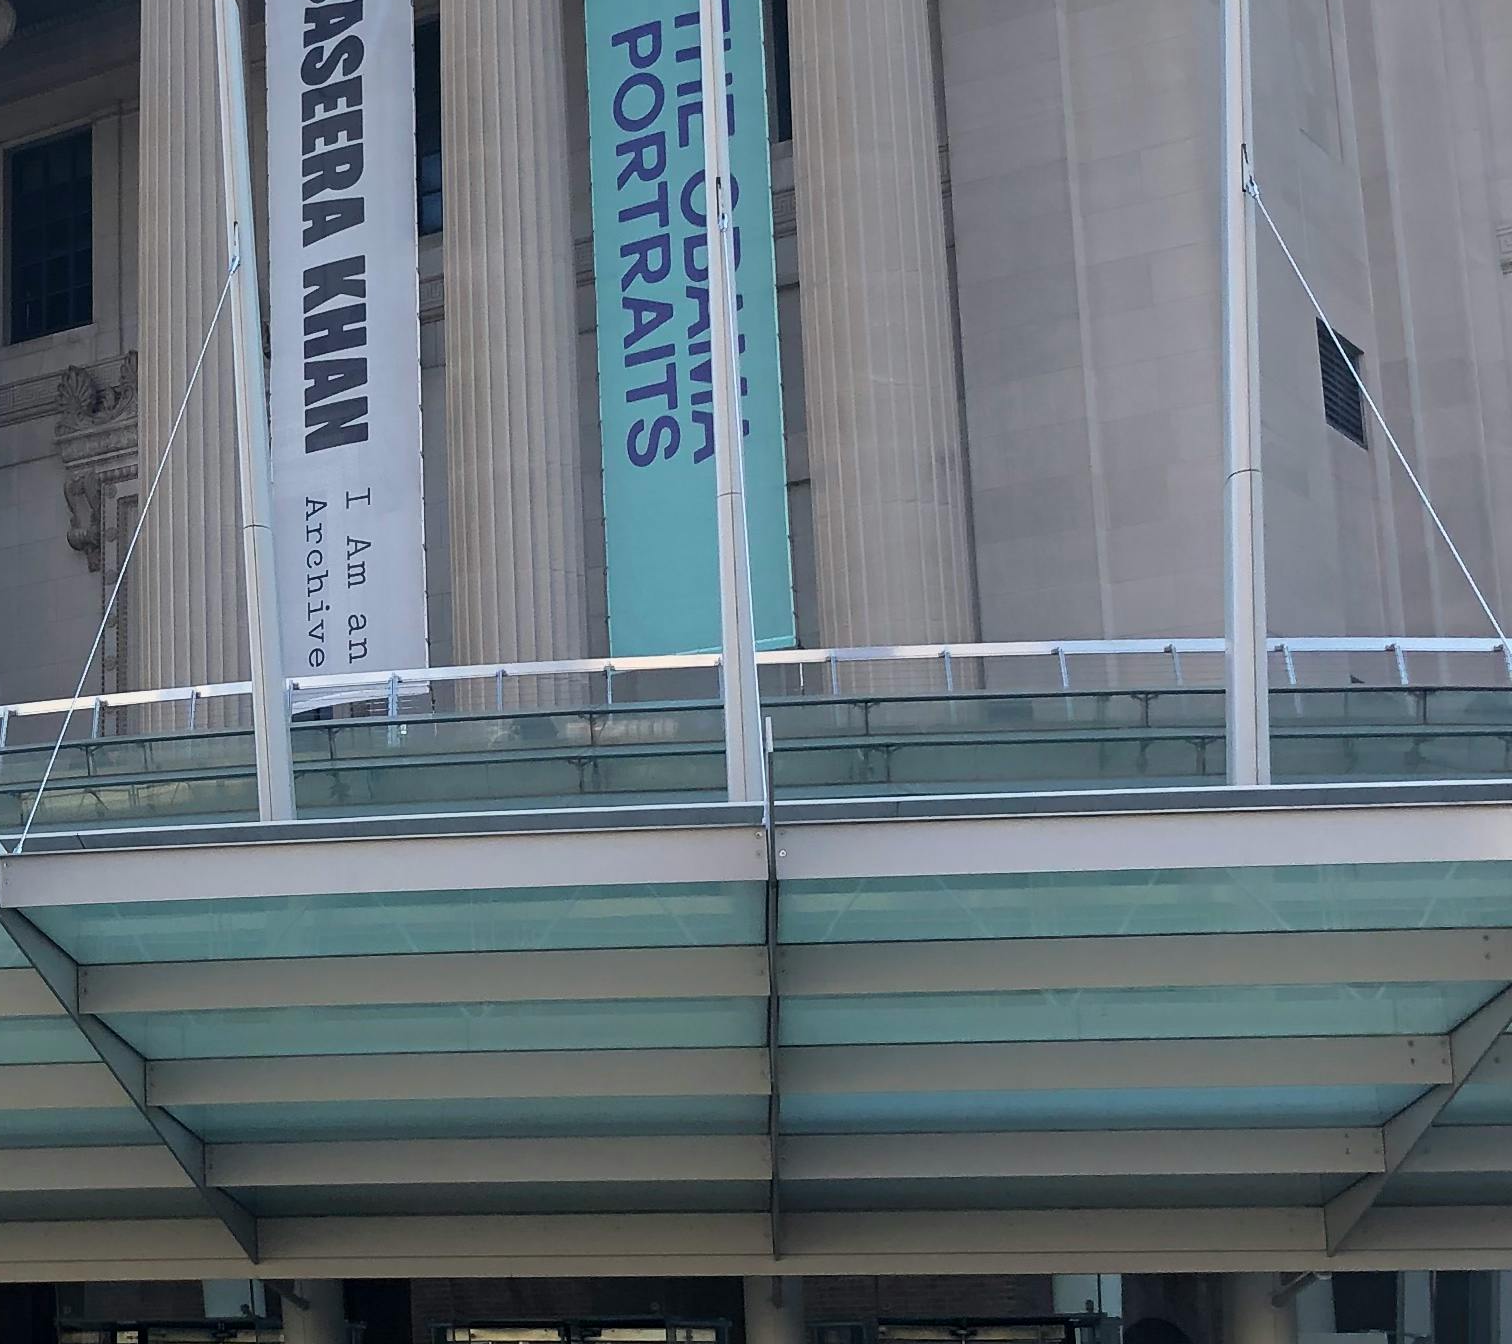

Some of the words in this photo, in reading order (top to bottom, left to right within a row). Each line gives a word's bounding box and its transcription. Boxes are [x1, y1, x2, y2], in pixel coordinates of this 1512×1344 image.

[611, 19, 679, 468] PORTRAITS
[302, 254, 369, 454] KHAN
[345, 487, 371, 509] I
[305, 496, 330, 668] Archive
[346, 535, 372, 589] Am
[347, 613, 368, 664] an
